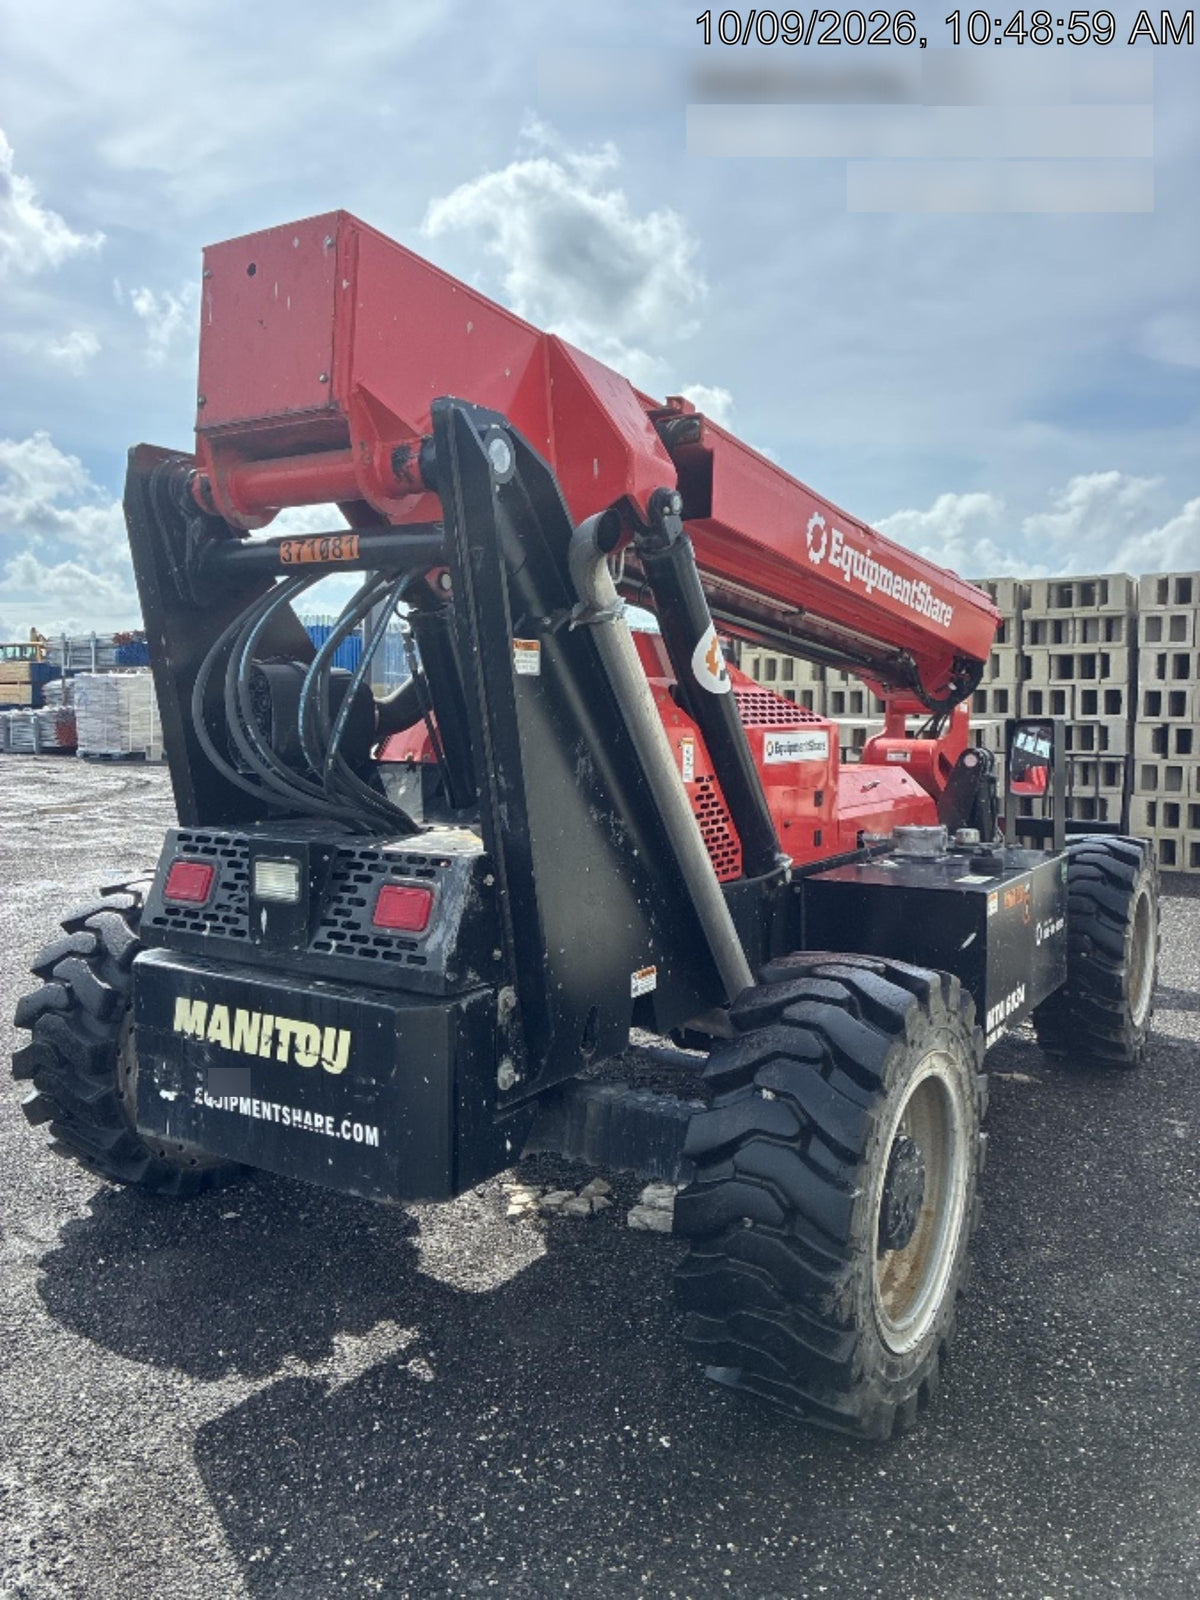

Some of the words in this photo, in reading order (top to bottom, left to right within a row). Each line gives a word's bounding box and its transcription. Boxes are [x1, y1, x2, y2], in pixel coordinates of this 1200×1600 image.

[281, 536, 356, 563] 371081
[828, 527, 953, 628] EquipmentShare
[173, 996, 352, 1075] MANITOU
